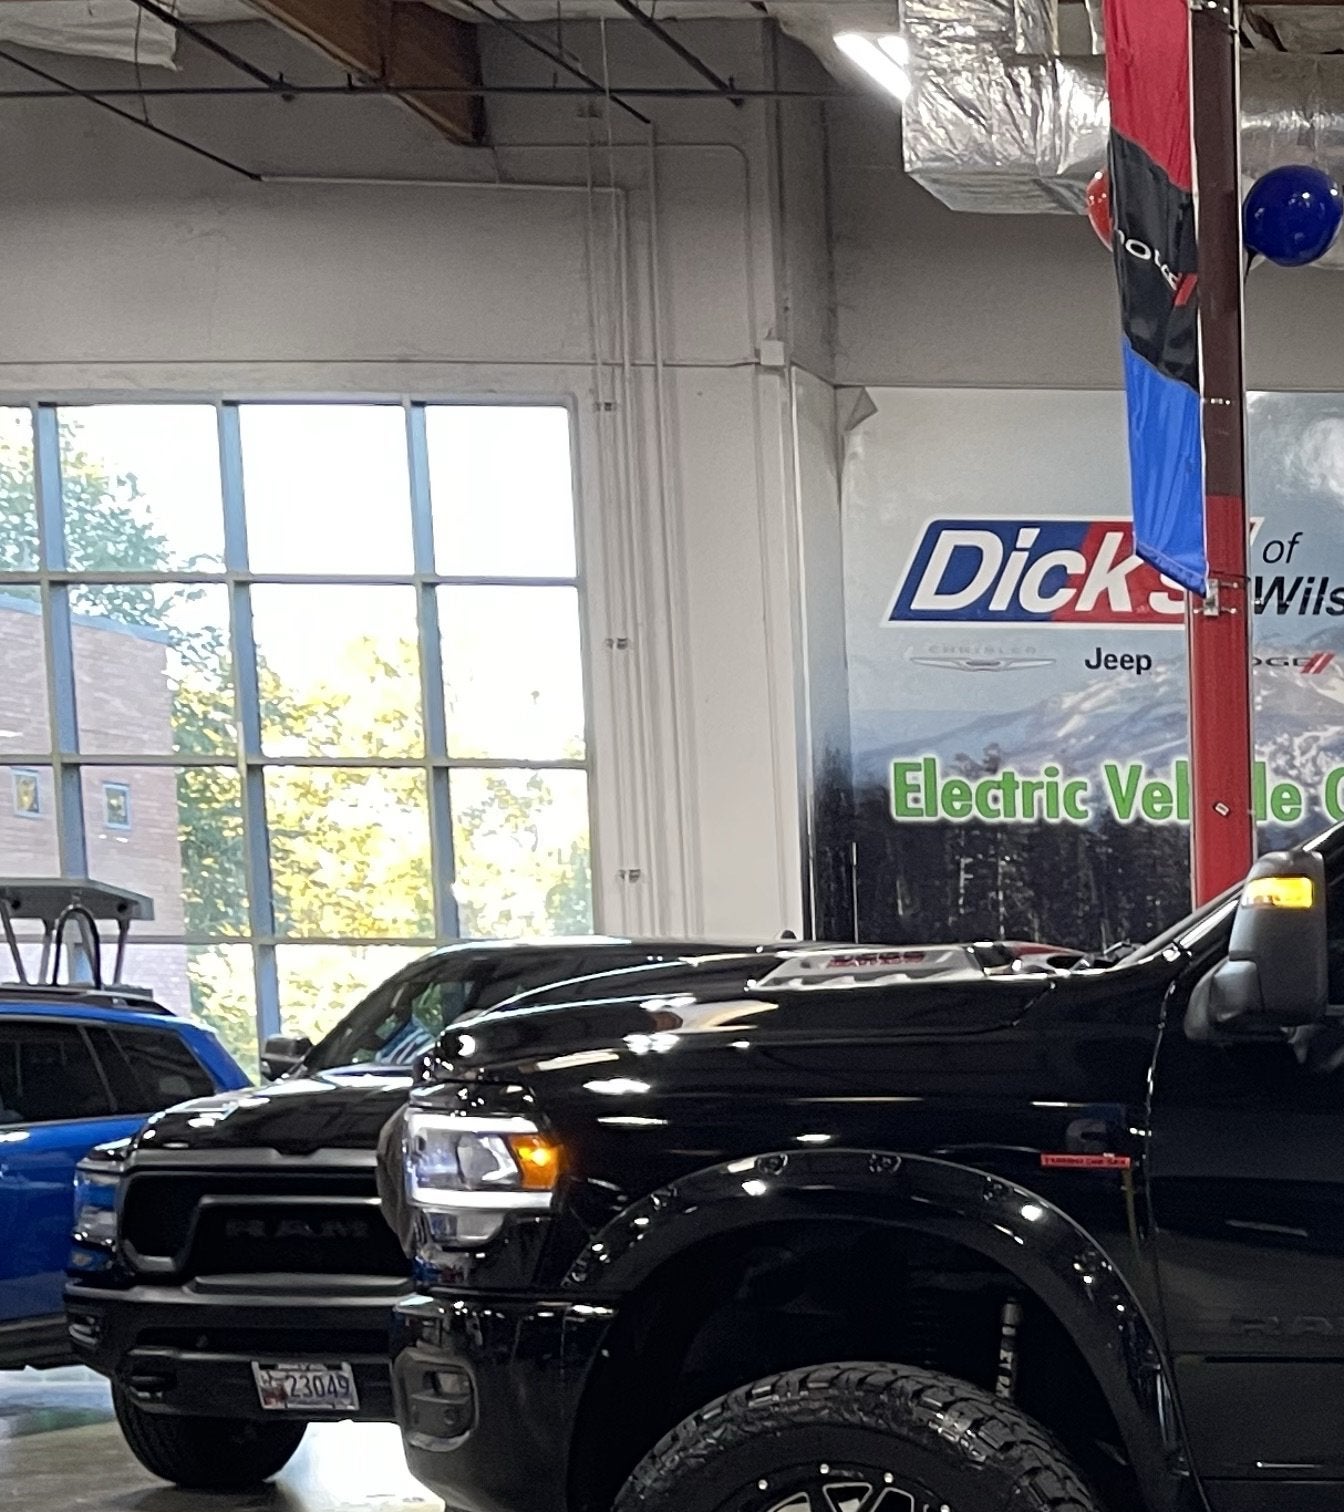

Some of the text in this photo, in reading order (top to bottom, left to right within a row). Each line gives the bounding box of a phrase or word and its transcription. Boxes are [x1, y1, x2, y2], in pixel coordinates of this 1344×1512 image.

[910, 527, 1187, 615] Dicks
[1262, 532, 1303, 564] of
[1084, 647, 1152, 675] Jeep
[892, 757, 1089, 821] Electric
[1104, 759, 1302, 822] Vele
